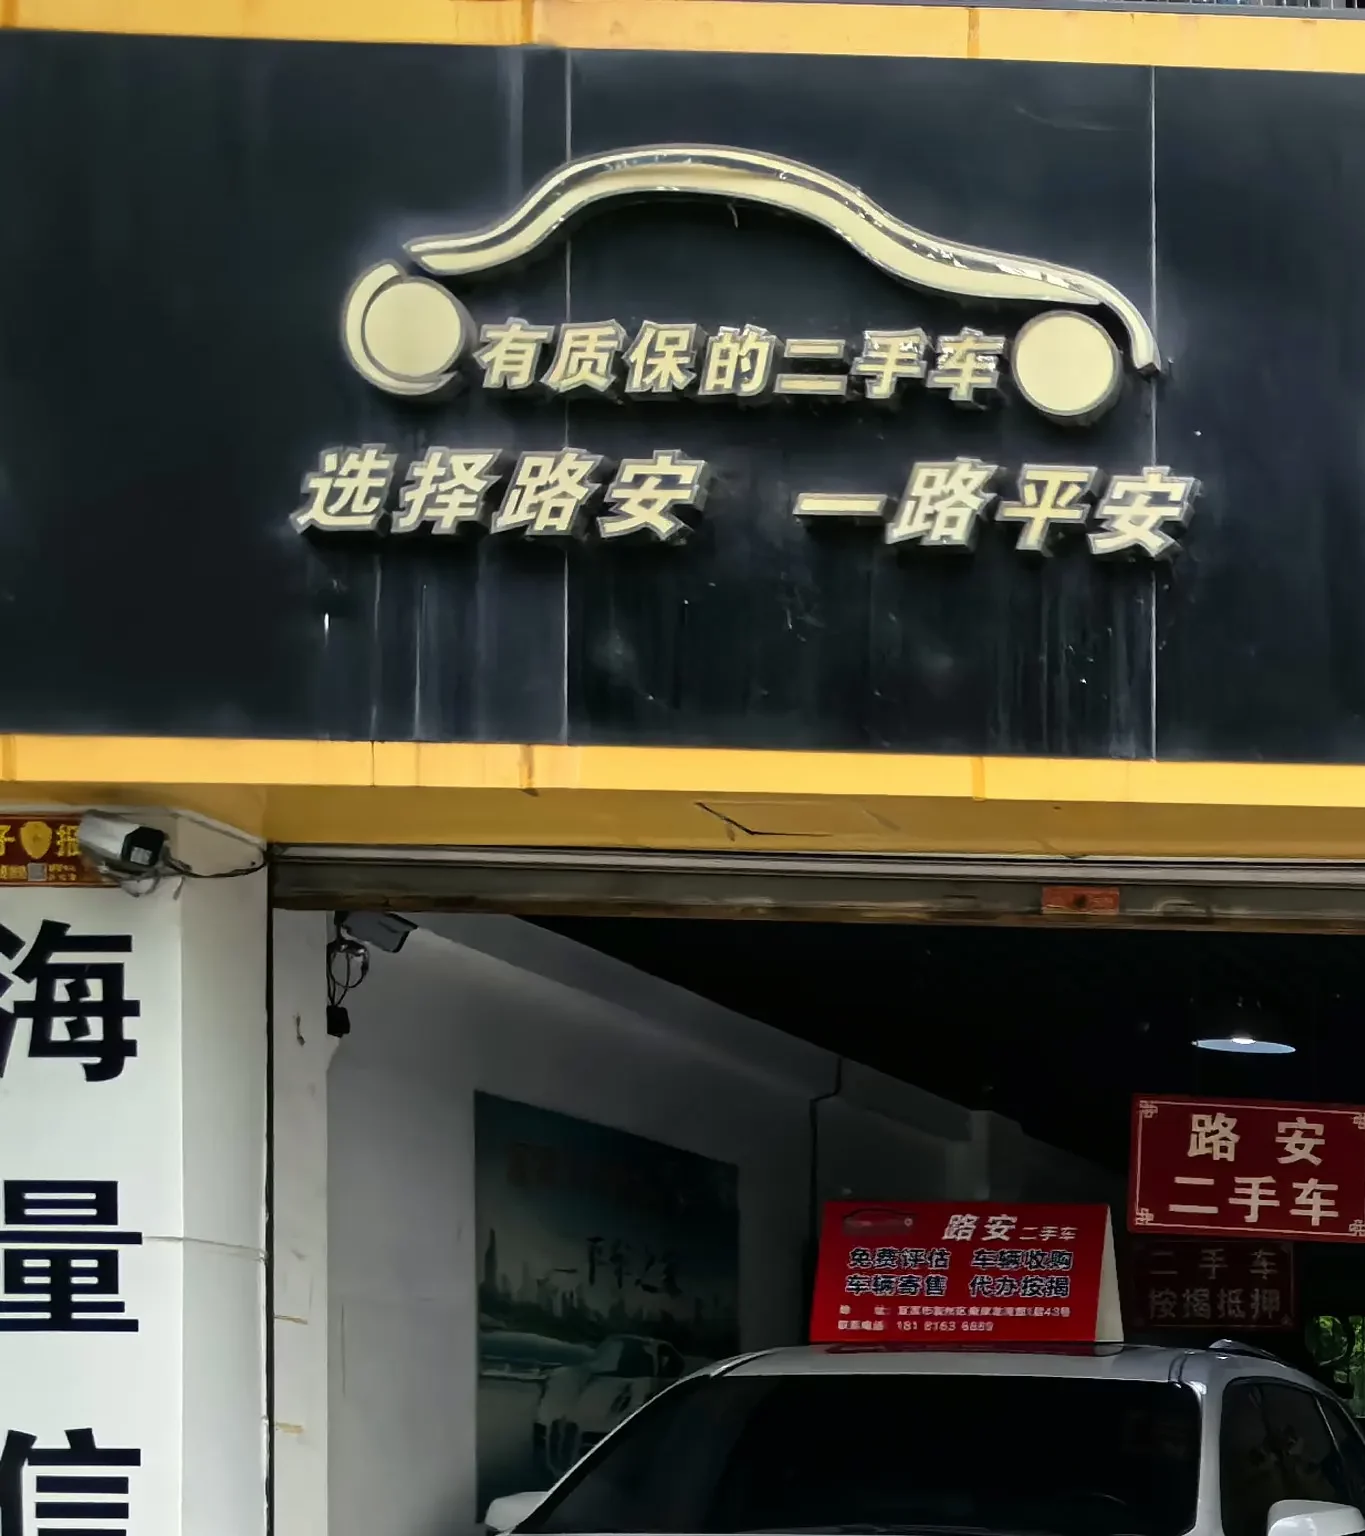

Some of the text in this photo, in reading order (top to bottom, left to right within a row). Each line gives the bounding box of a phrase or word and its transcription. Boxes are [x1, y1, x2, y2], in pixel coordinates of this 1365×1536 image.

[476, 317, 1007, 400] 有质保的二手车
[295, 444, 1200, 558] 选择路安 一路平安
[1187, 1112, 1326, 1167] 路安
[1168, 1175, 1339, 1227] 二手车
[942, 1213, 1079, 1242] 路安 二手车
[846, 1247, 1074, 1272] 免费评估 车辆收购
[1148, 1247, 1280, 1281] 二手车
[844, 1274, 1071, 1299] 车辆寄售 代办按揭
[1148, 1287, 1281, 1320] 按揭抵押
